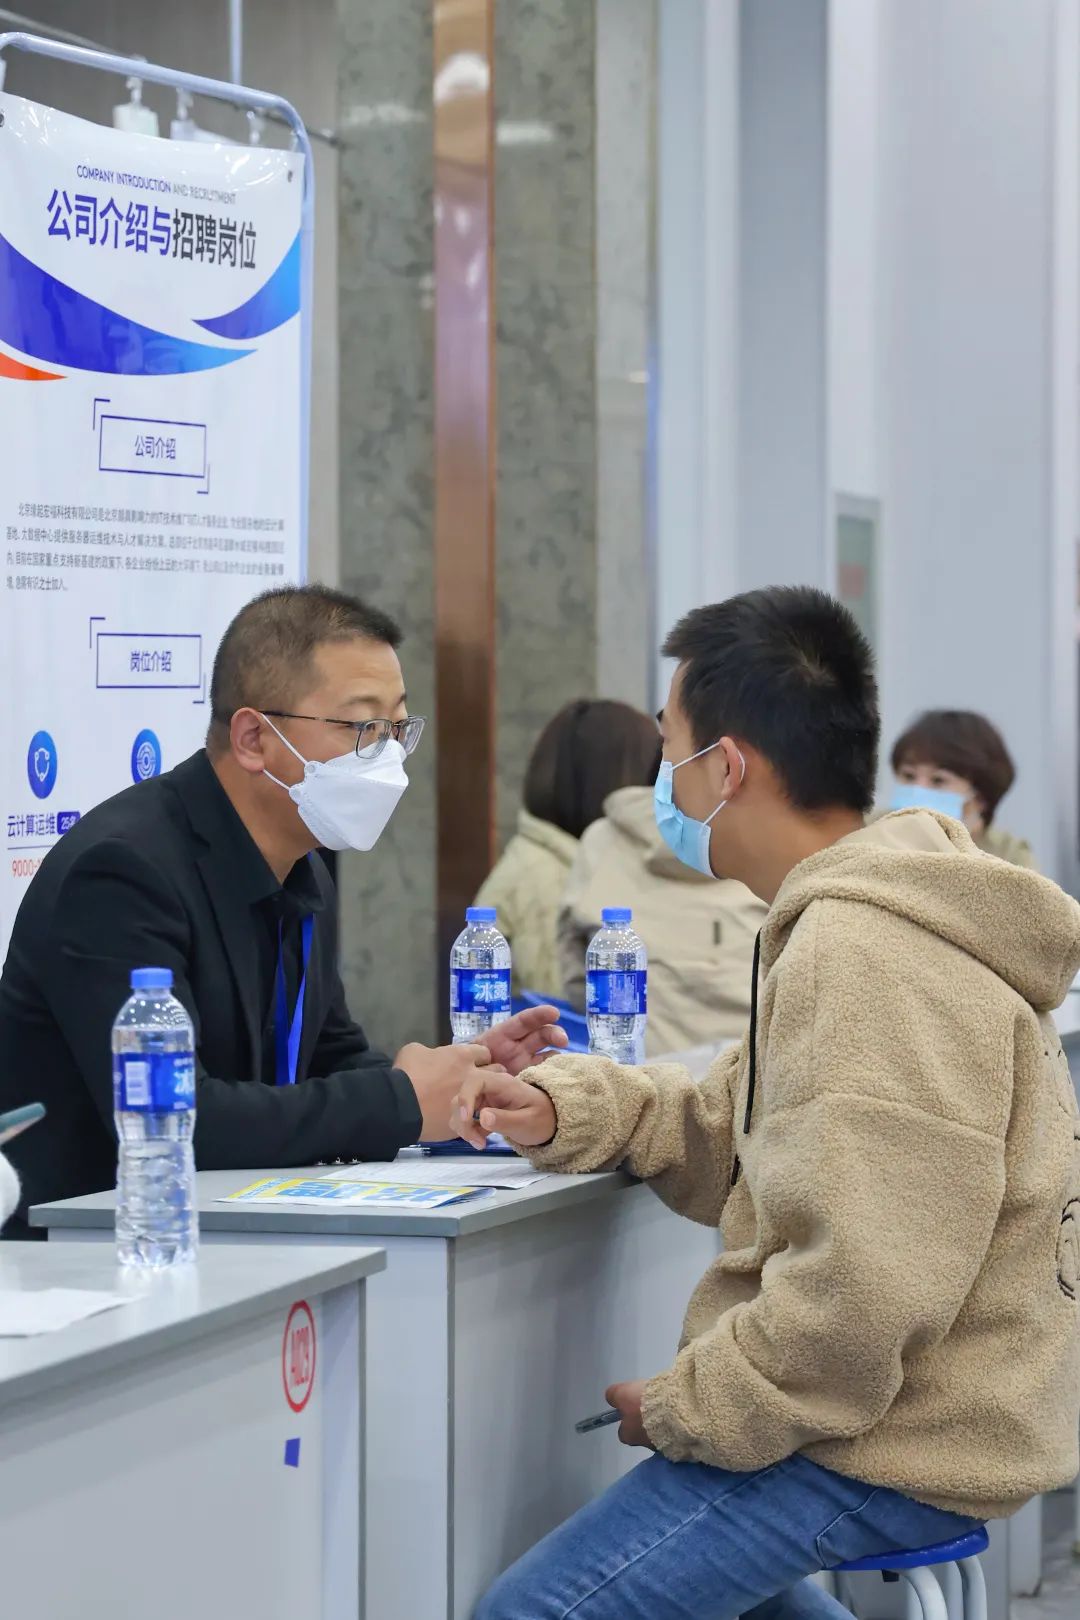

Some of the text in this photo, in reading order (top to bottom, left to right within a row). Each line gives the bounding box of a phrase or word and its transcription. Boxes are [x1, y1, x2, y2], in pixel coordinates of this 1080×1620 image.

[76, 165, 114, 184] COMPANY
[116, 172, 171, 194] INTRODUCTION
[173, 184, 189, 198] AND
[46, 188, 257, 269] 公司介绍与招聘岗位
[134, 434, 176, 460] 公司介绍
[129, 650, 172, 673] 岗位介绍
[7, 813, 56, 838] 云计算运维
[12, 859, 43, 878] 9000-
